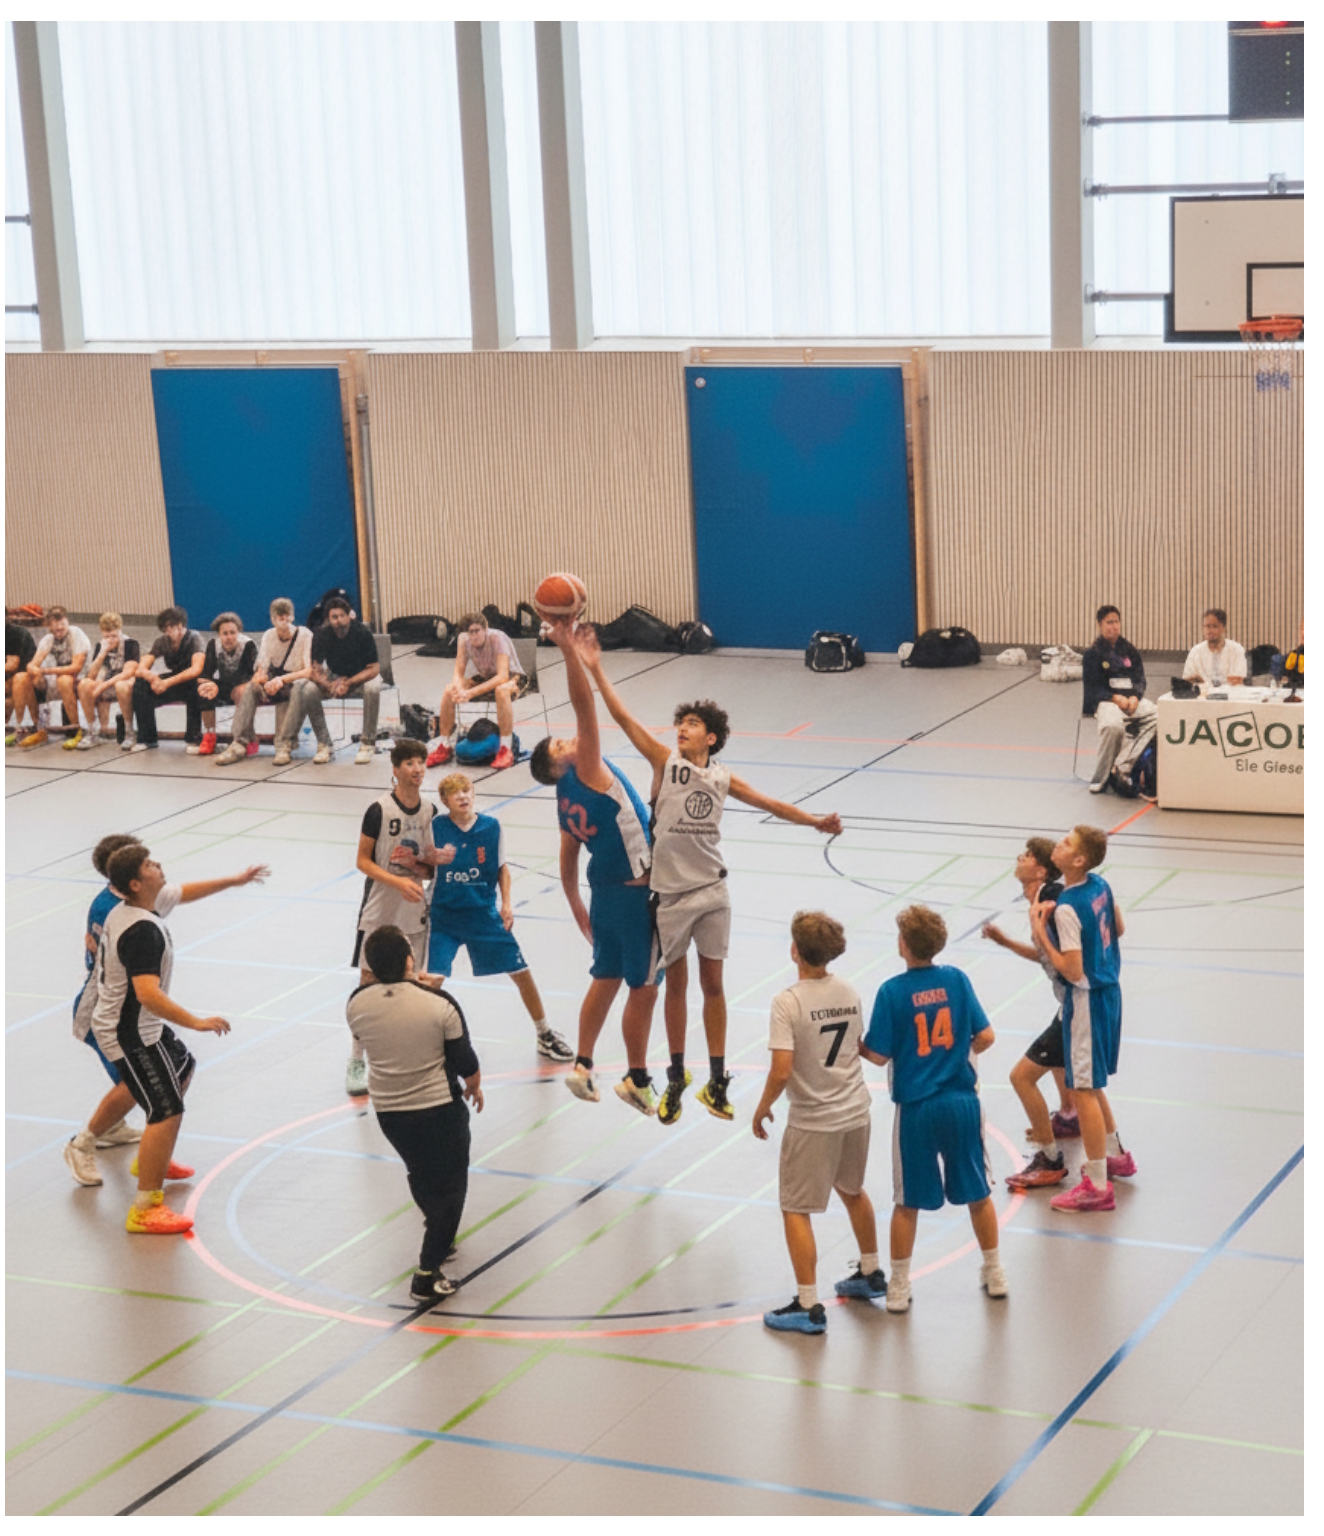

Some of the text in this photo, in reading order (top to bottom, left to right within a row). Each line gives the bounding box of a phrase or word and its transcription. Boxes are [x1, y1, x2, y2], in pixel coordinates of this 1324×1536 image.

[670, 764, 691, 785] 10
[819, 1021, 849, 1068] 7
[914, 1006, 954, 1057] 14
